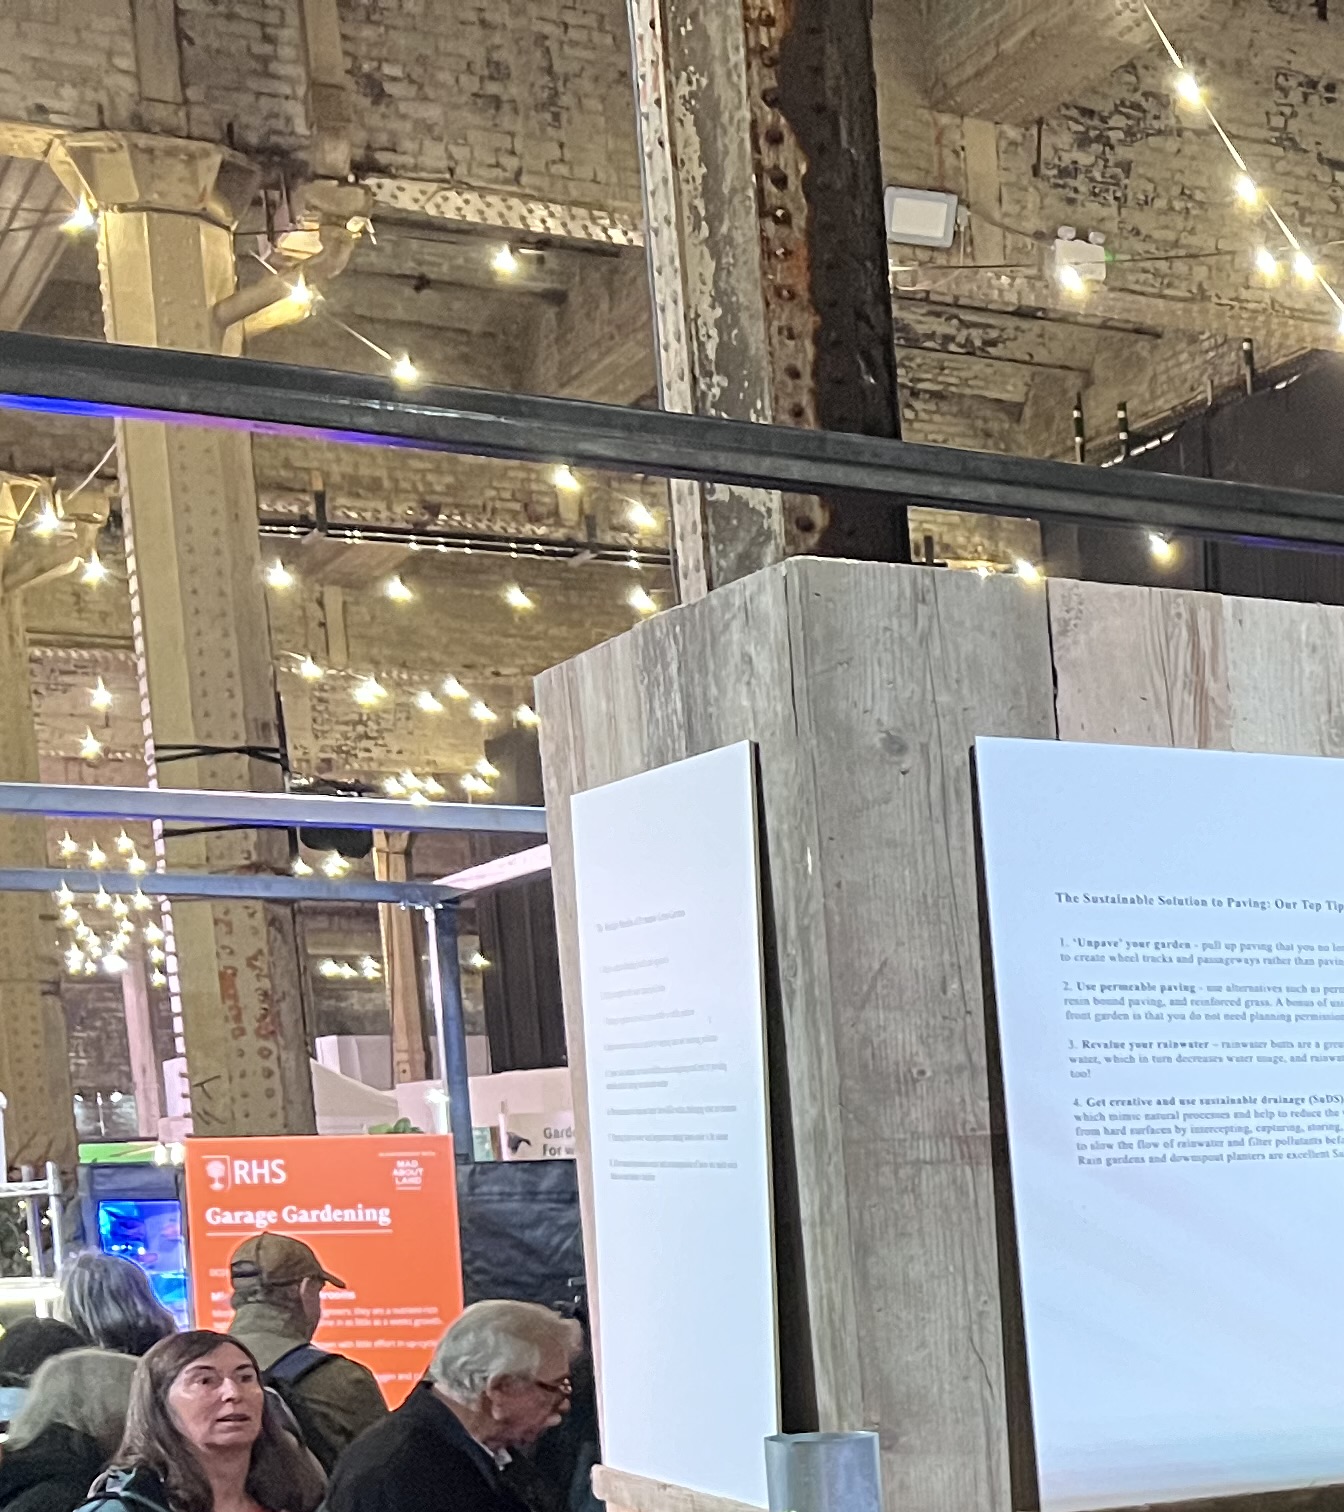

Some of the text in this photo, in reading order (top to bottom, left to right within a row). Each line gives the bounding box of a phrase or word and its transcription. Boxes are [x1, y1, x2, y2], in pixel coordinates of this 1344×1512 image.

[1056, 894, 1079, 904] The
[1083, 894, 1154, 906] Sustainable
[1158, 896, 1207, 907] Solution
[1211, 898, 1222, 908] to
[1227, 898, 1270, 911] Paving:
[1274, 899, 1296, 910] Our
[1302, 900, 1321, 912] Top
[234, 1159, 286, 1184] RHS
[392, 1168, 424, 1176] ABOUT
[205, 1203, 391, 1229] Garage Gardening
